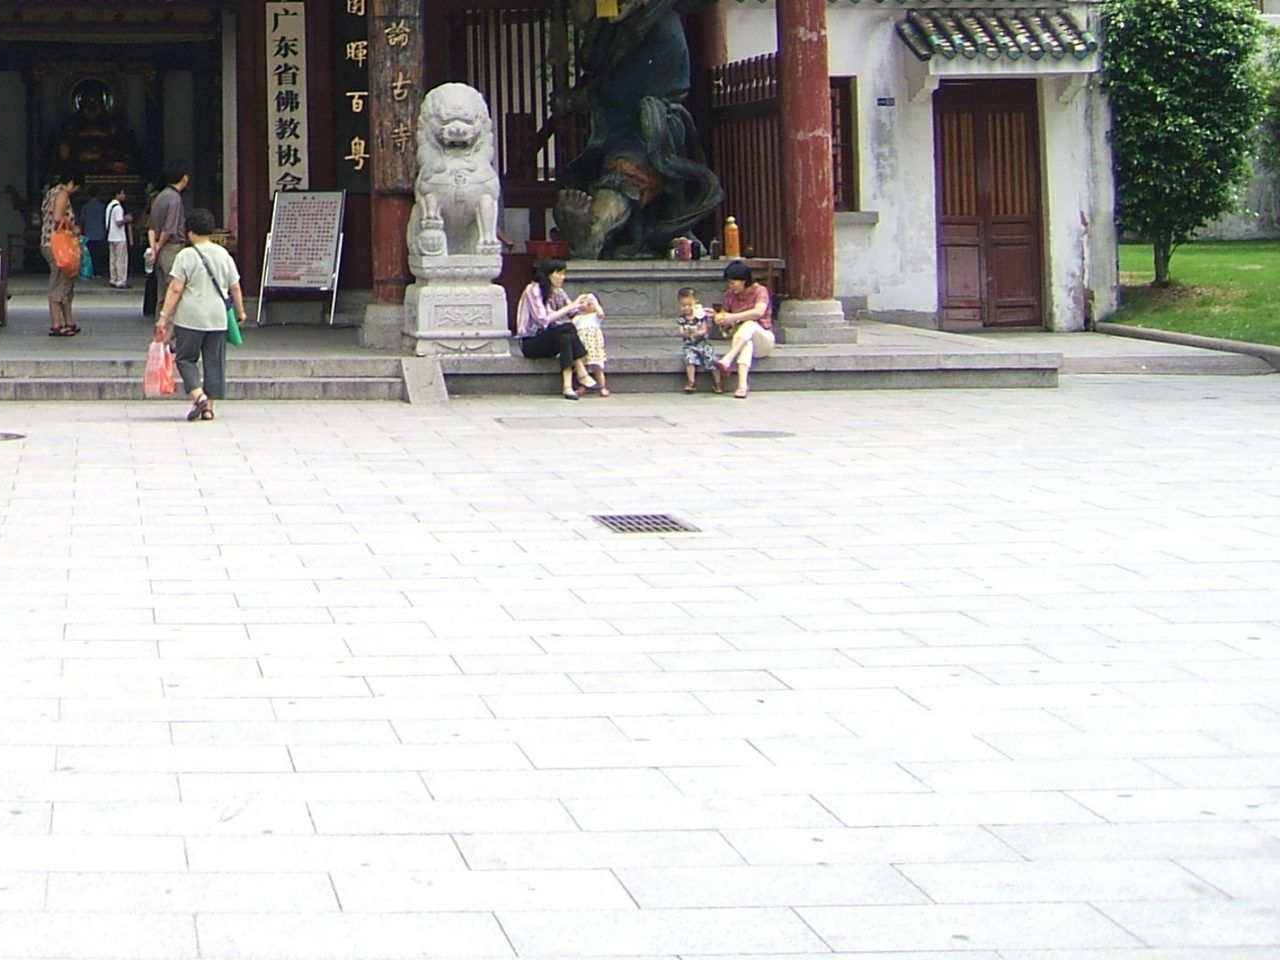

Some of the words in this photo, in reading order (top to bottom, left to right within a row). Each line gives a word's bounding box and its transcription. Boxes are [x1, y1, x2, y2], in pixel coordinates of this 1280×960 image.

[272, 8, 302, 192] 广东省佛教协会
